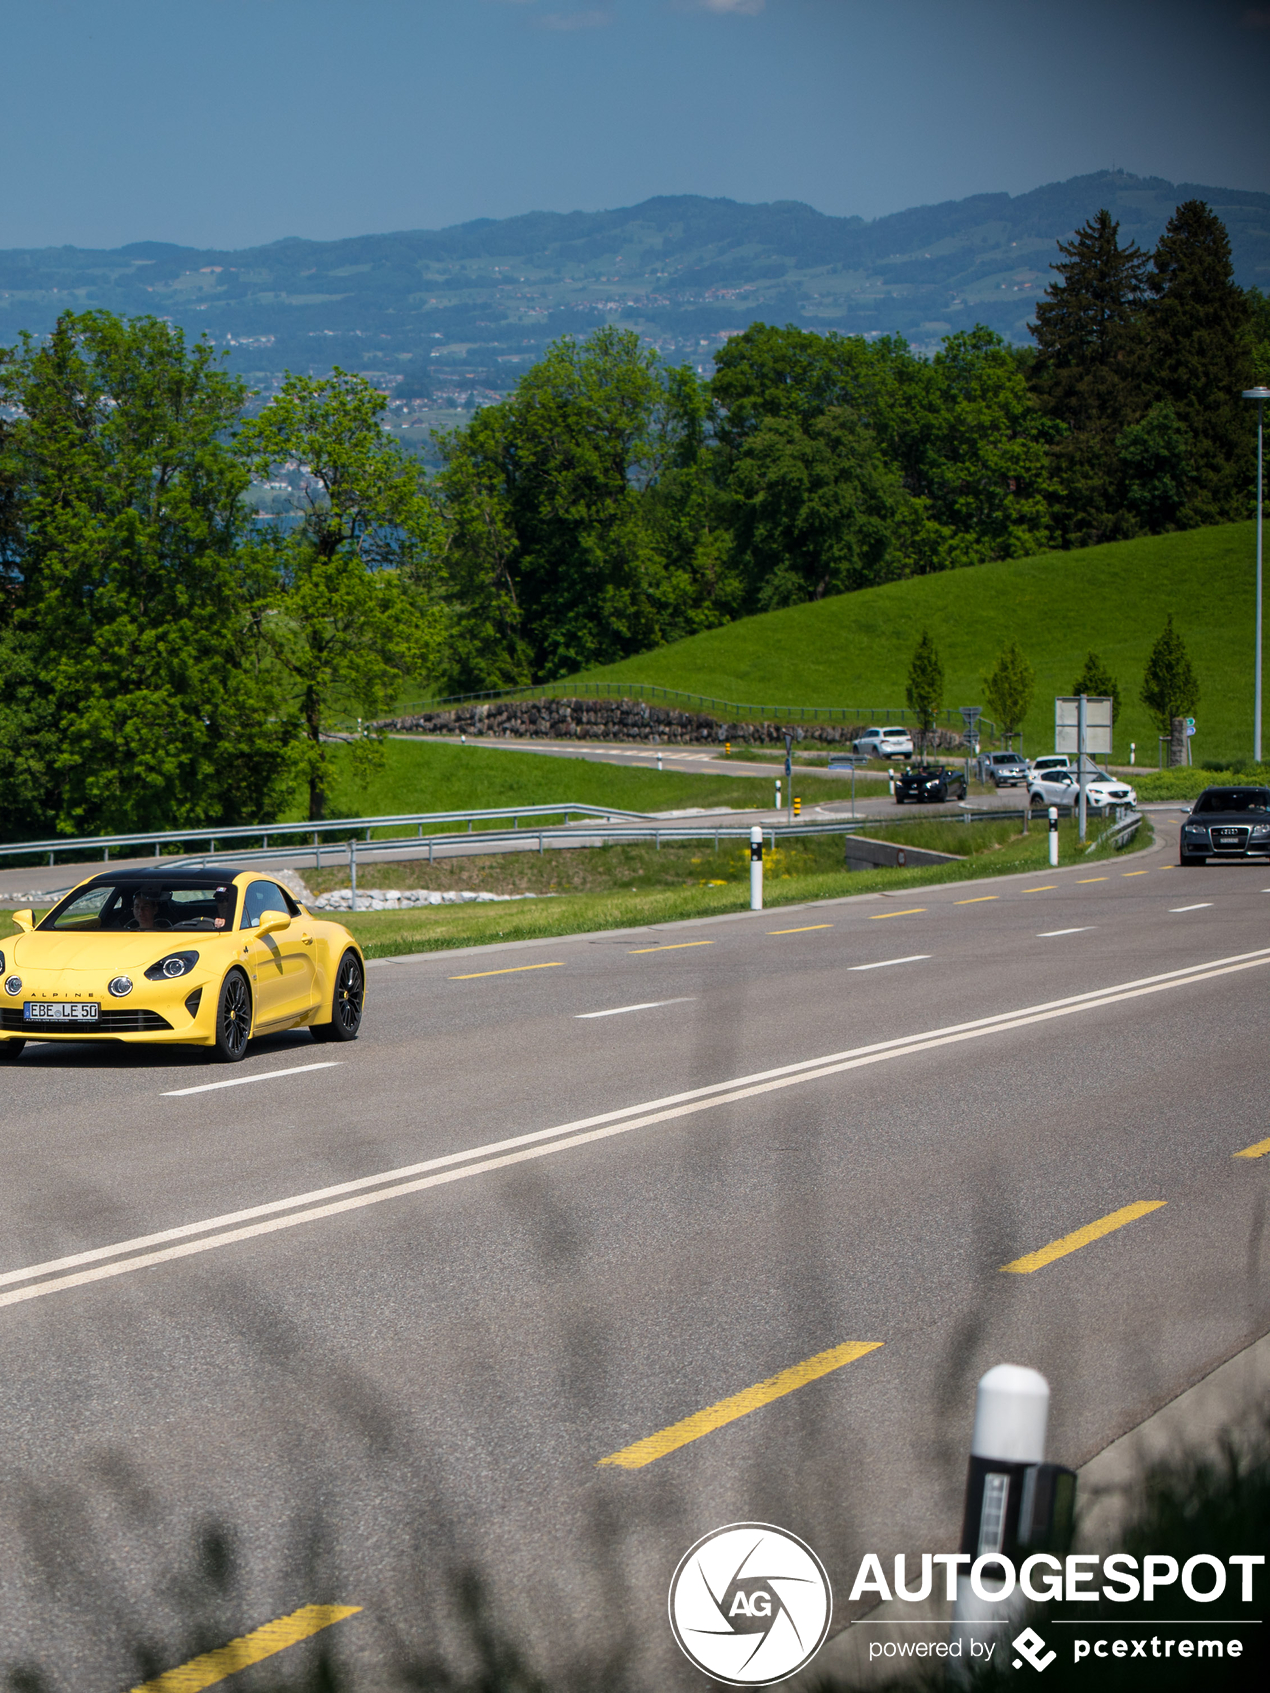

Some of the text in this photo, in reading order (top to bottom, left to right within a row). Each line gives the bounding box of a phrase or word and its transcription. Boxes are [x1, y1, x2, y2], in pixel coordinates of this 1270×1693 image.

[31, 1005, 54, 1017] EBE
[62, 1005, 78, 1017] LE
[81, 1005, 97, 1017] 50
